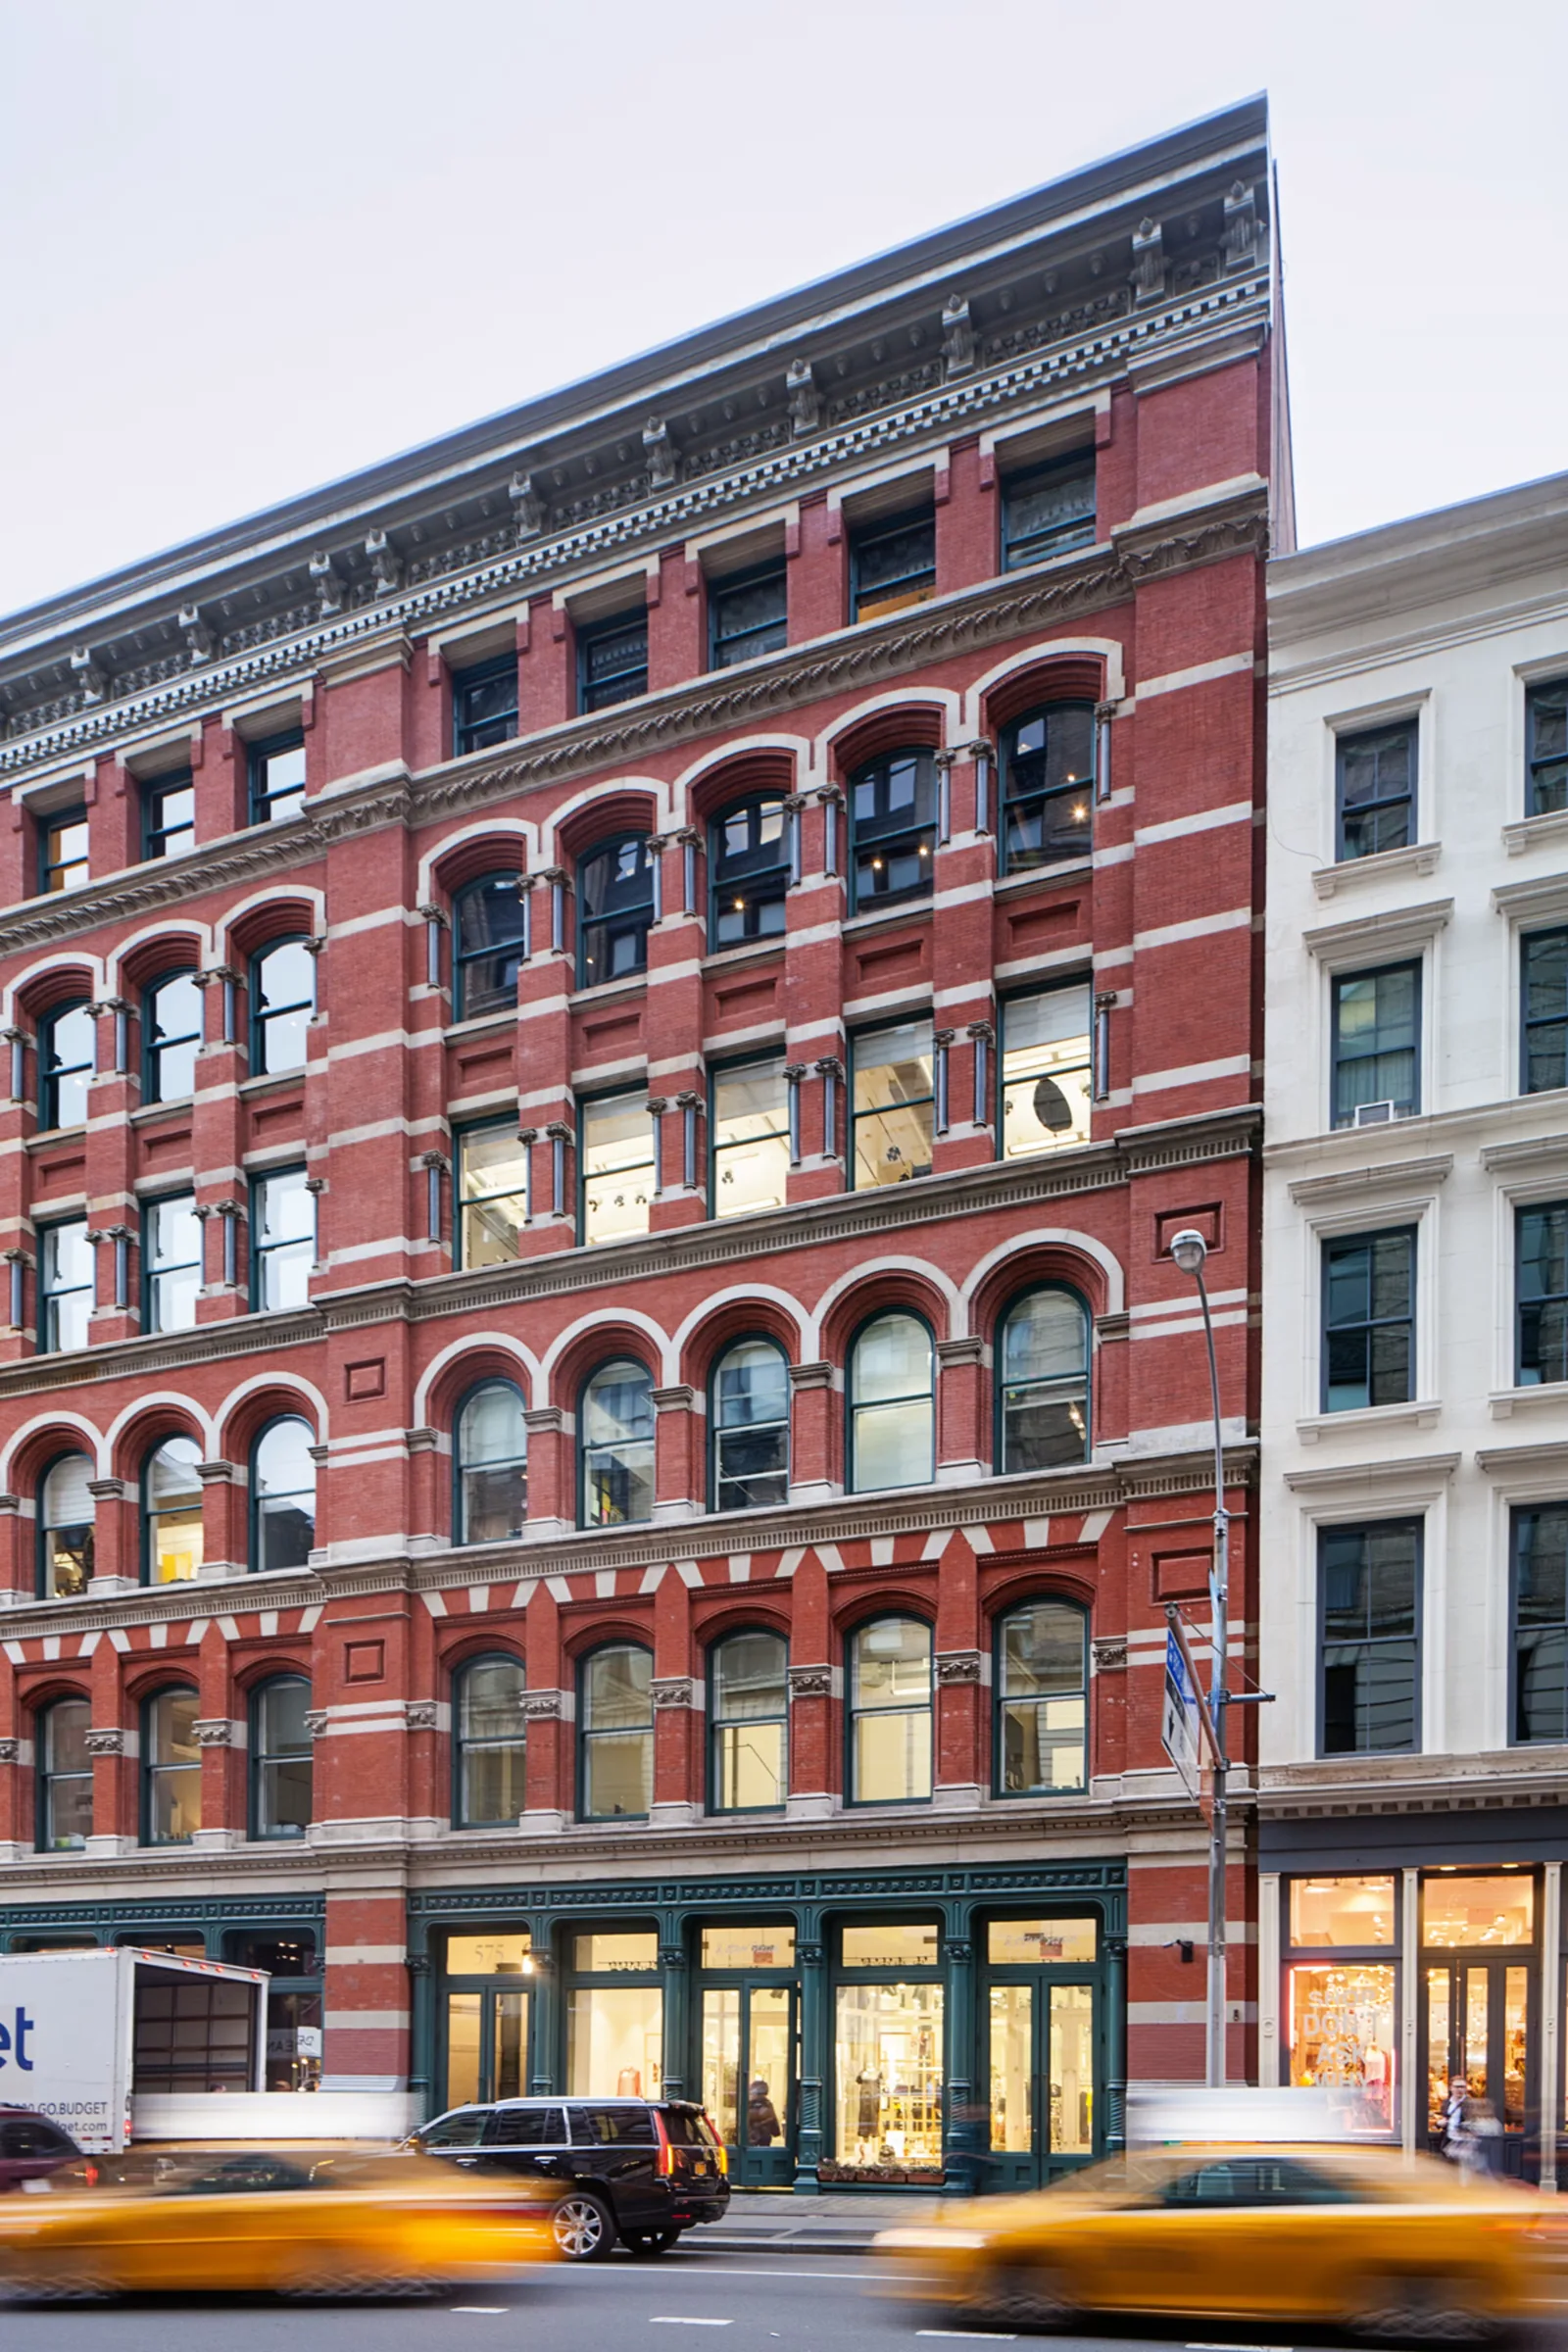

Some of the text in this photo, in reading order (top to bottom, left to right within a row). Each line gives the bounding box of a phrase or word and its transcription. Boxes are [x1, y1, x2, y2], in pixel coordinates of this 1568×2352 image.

[474, 1943, 505, 1966] 575
[1308, 1989, 1375, 2008] SHOP
[0, 2007, 34, 2071] t
[1316, 2042, 1367, 2065] ASK
